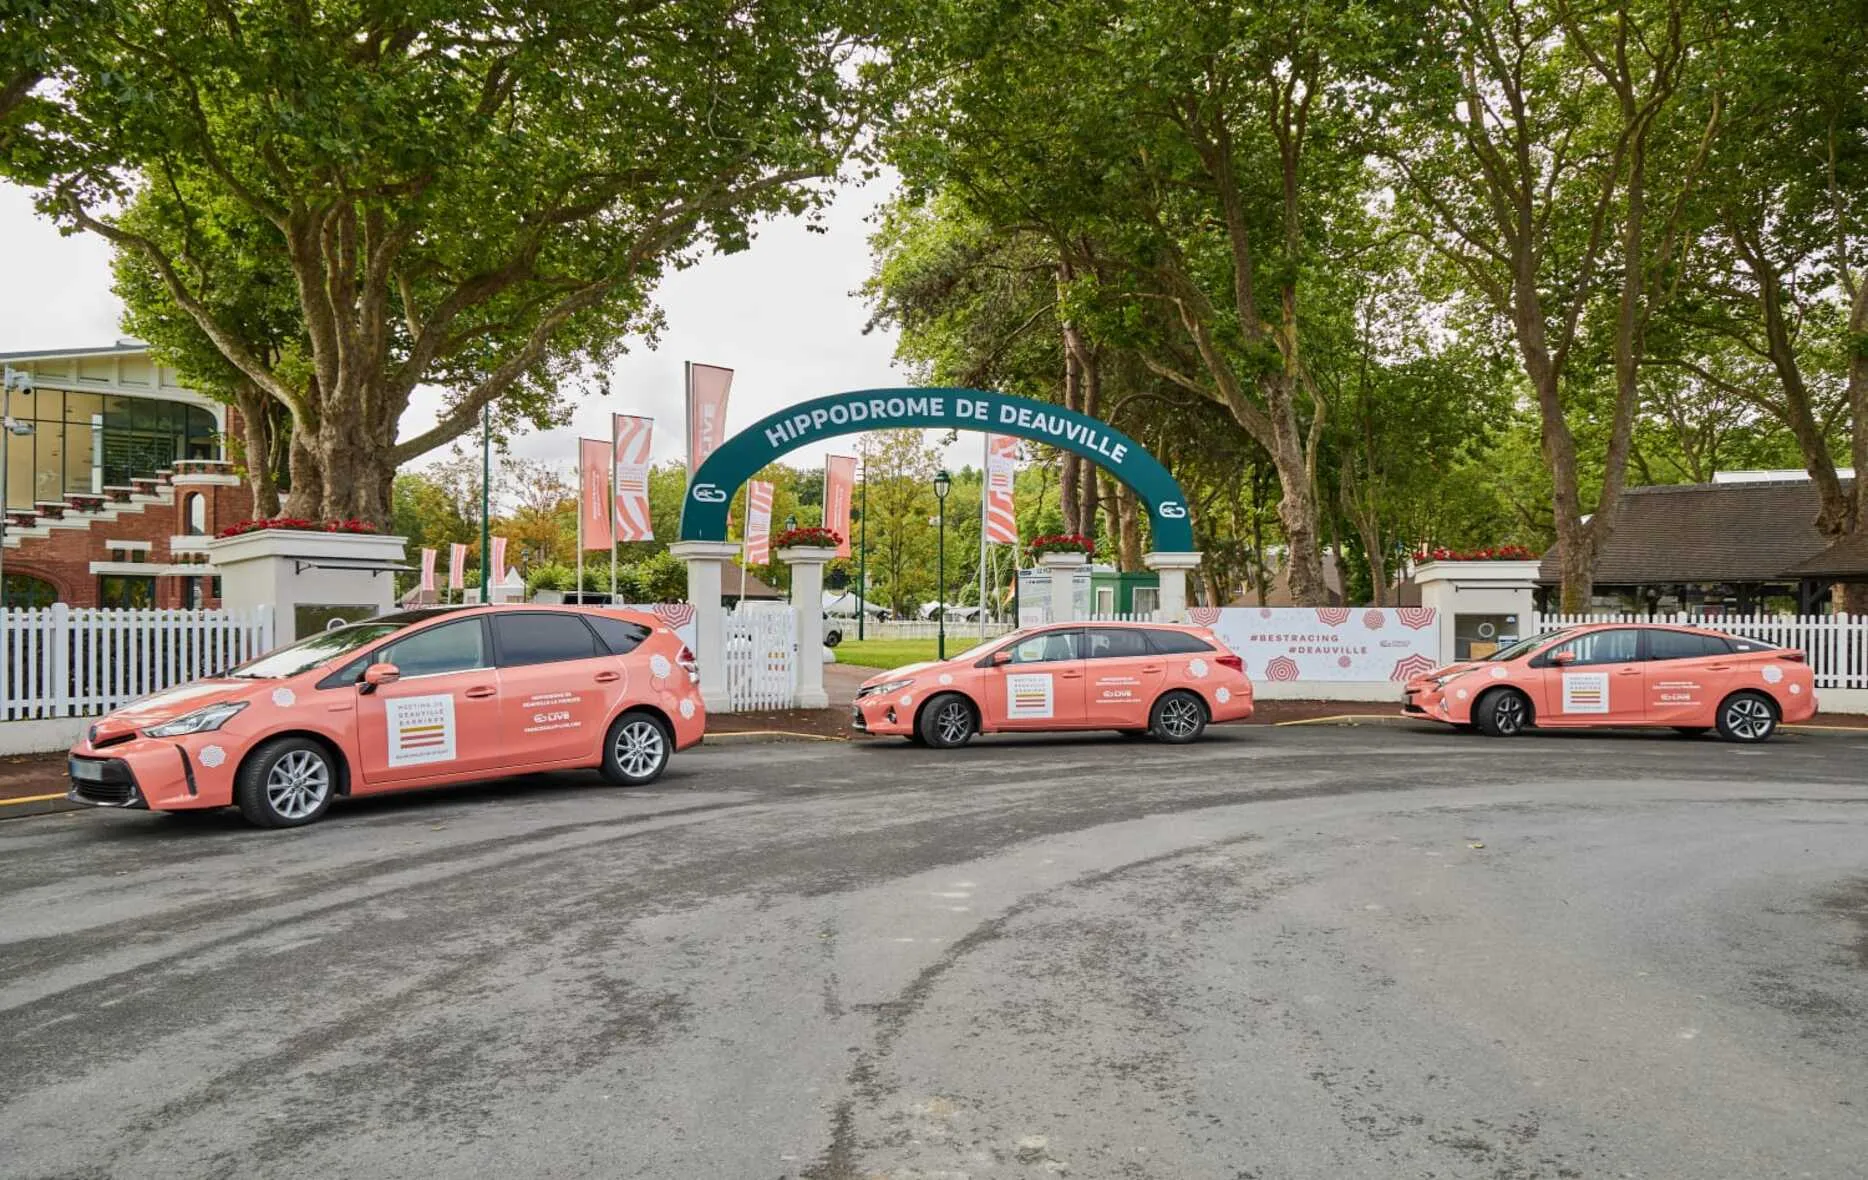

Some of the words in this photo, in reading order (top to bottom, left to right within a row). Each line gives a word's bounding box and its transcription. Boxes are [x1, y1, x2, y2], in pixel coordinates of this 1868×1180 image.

[764, 398, 945, 448] HIPPODROME
[956, 398, 989, 420] DE
[1000, 404, 1128, 463] DEAUVILLE
[1250, 634, 1339, 642] #BESTRACING
[1288, 646, 1368, 654] #DEAUVILLE
[547, 711, 570, 721] LIVE
